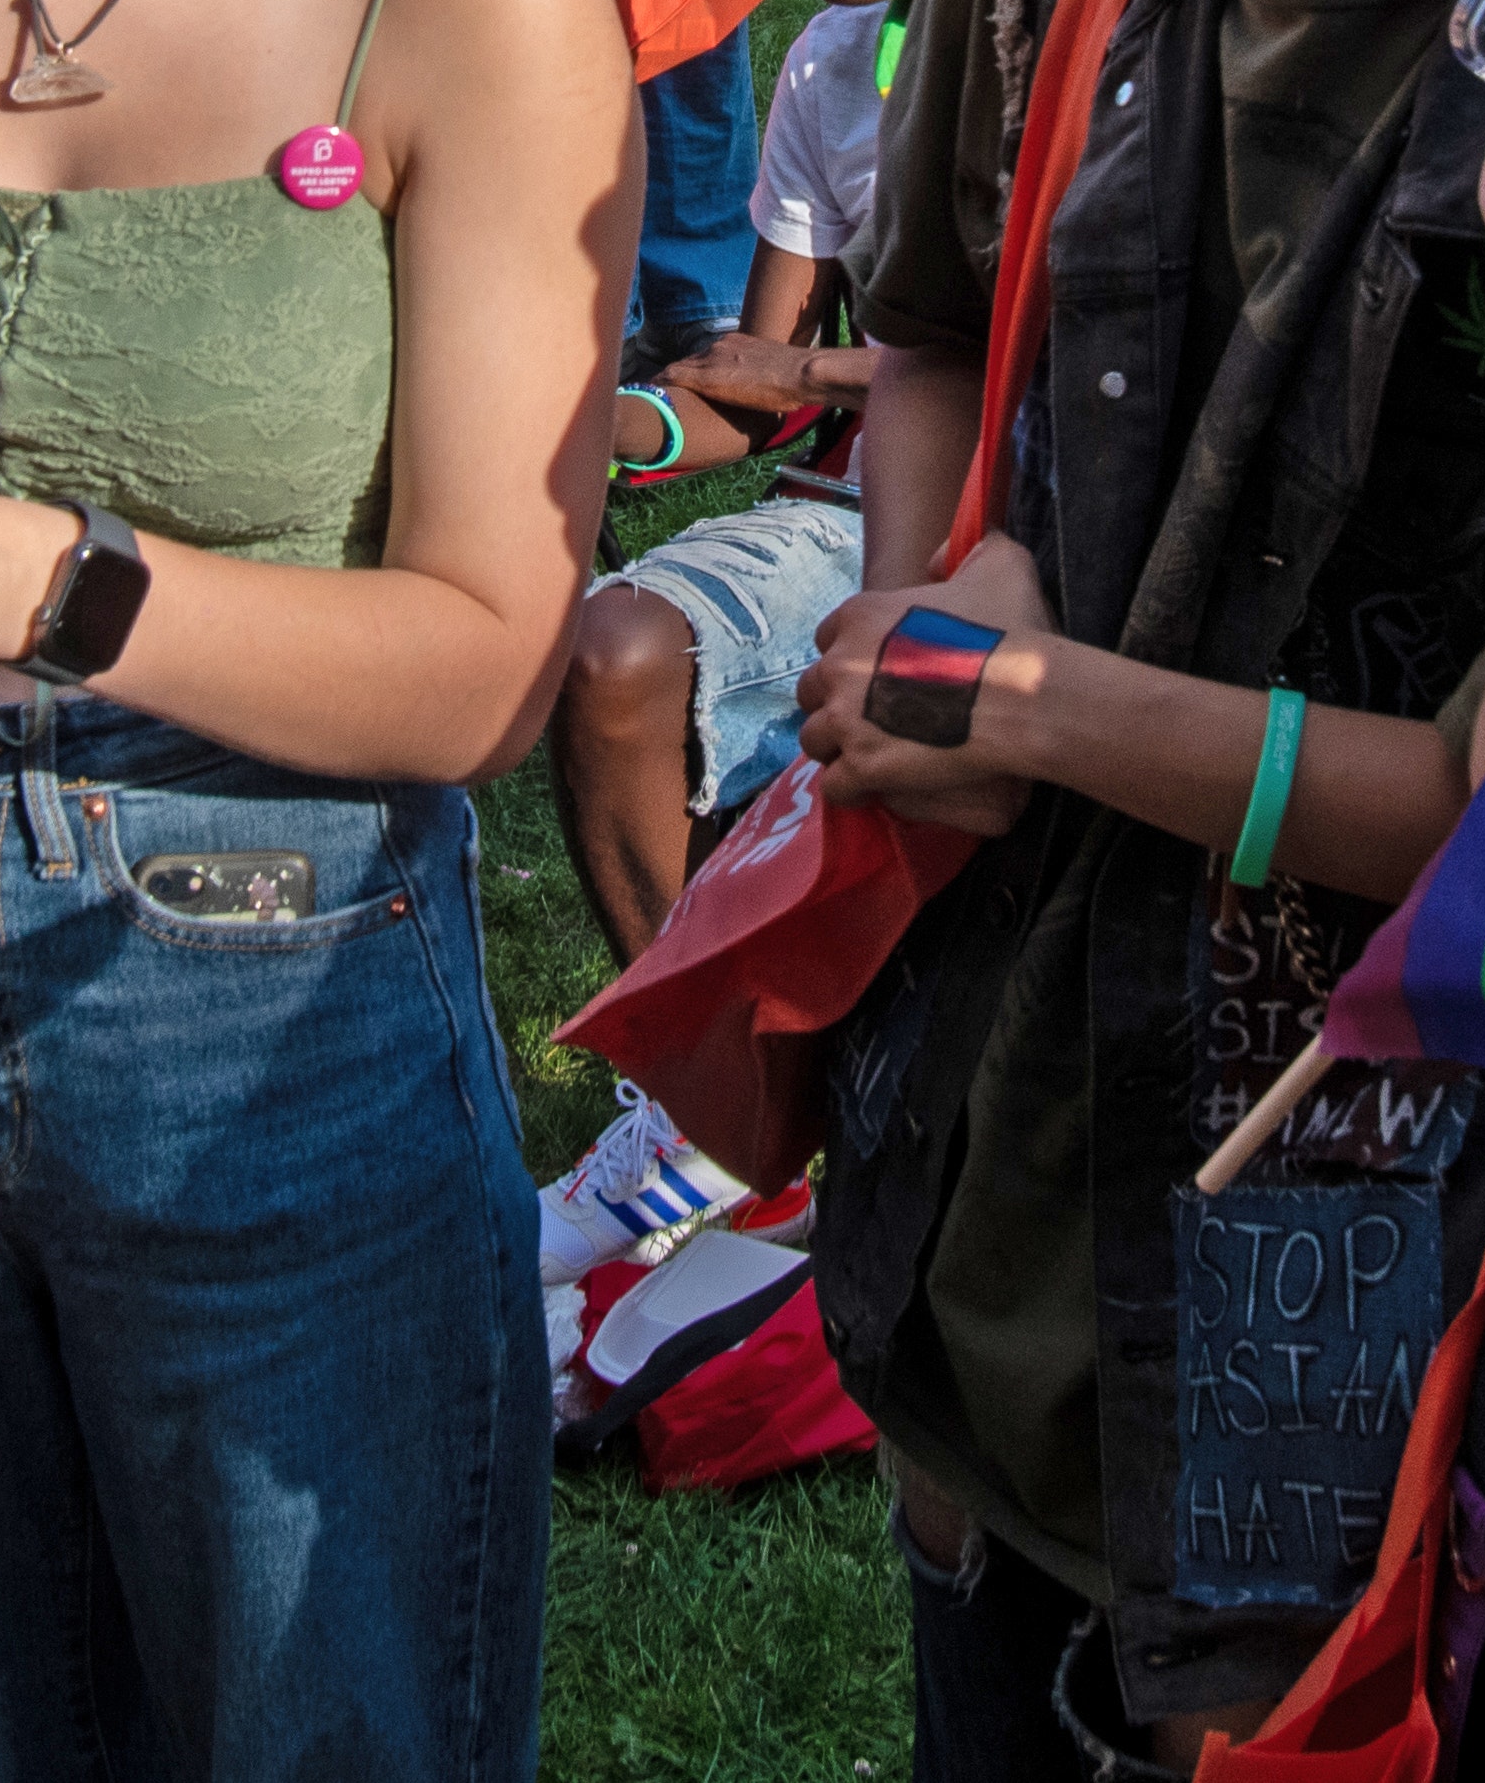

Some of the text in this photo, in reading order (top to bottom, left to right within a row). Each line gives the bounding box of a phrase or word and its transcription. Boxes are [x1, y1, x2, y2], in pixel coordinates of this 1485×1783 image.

[1192, 1215, 1402, 1332] STOP
[1188, 1339, 1436, 1436] ASIAN
[1188, 1476, 1383, 1564] HATE
